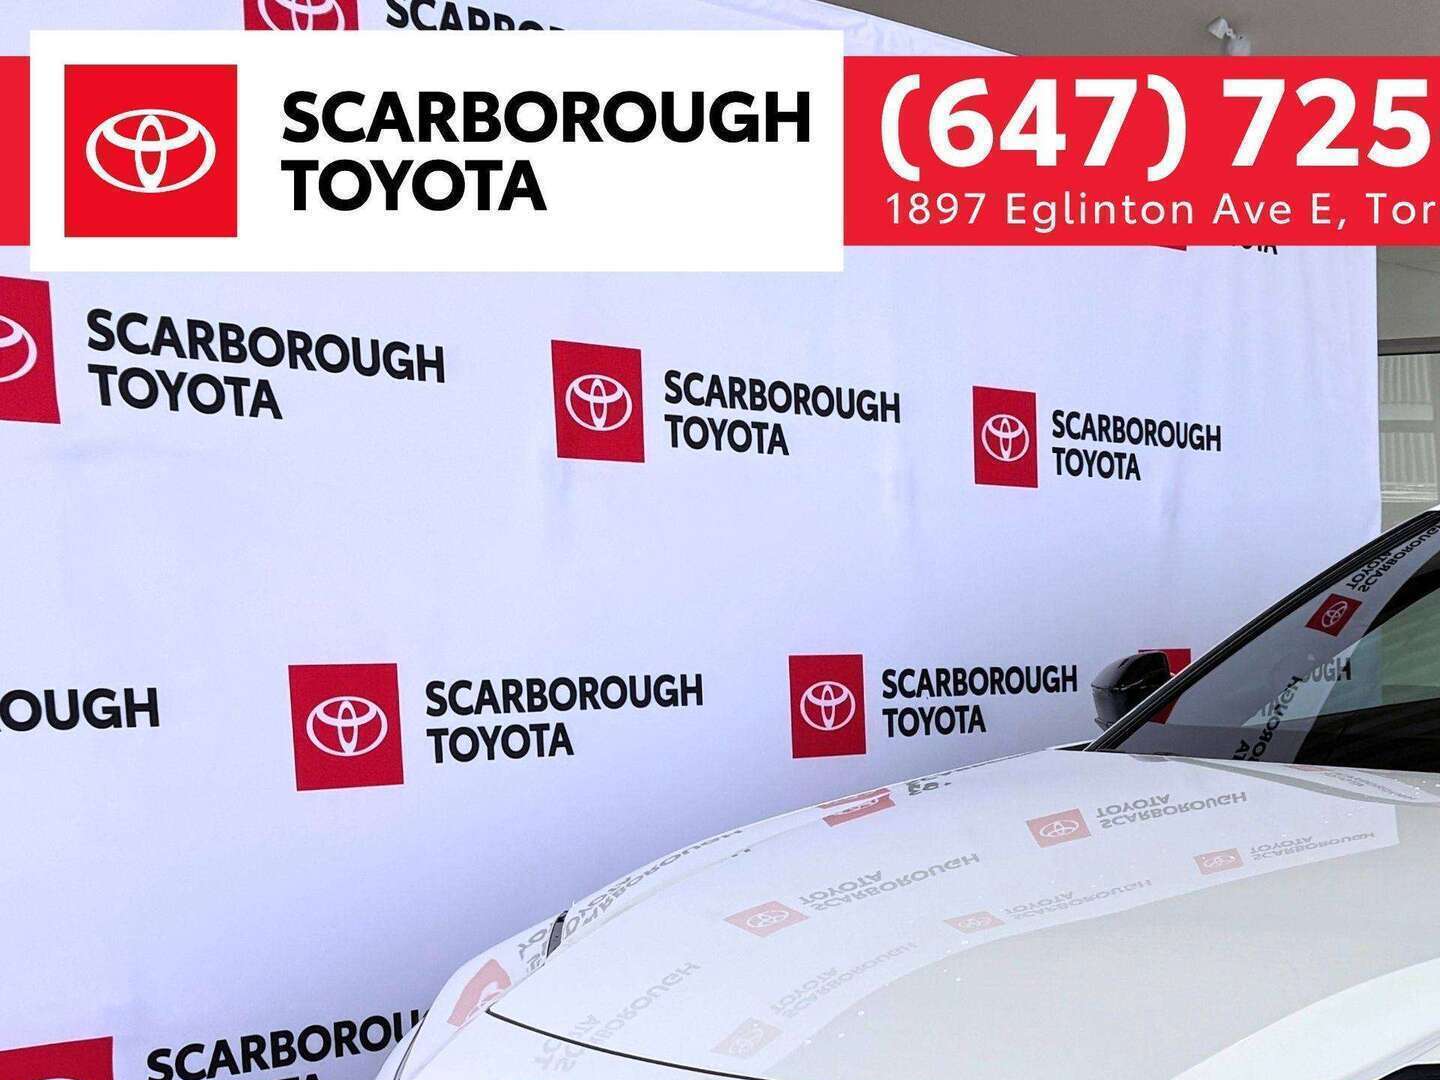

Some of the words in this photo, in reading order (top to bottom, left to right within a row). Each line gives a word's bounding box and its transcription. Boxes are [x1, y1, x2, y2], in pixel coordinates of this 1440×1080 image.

[87, 308, 446, 384] SCARBOROUGH
[88, 363, 283, 420] TOYOTA
[664, 370, 901, 424] SCARBOROUGH
[664, 414, 790, 456] TOYOTA
[1051, 409, 1222, 452] SCARBOROUGH
[1051, 446, 1142, 481] TOYOTA
[425, 673, 704, 717] SCARBOROUGH
[882, 664, 1078, 700] SCARBOROUGH
[0, 687, 160, 732] OUGH
[882, 704, 987, 738] TOYOTA
[426, 722, 575, 764] TOYOTA
